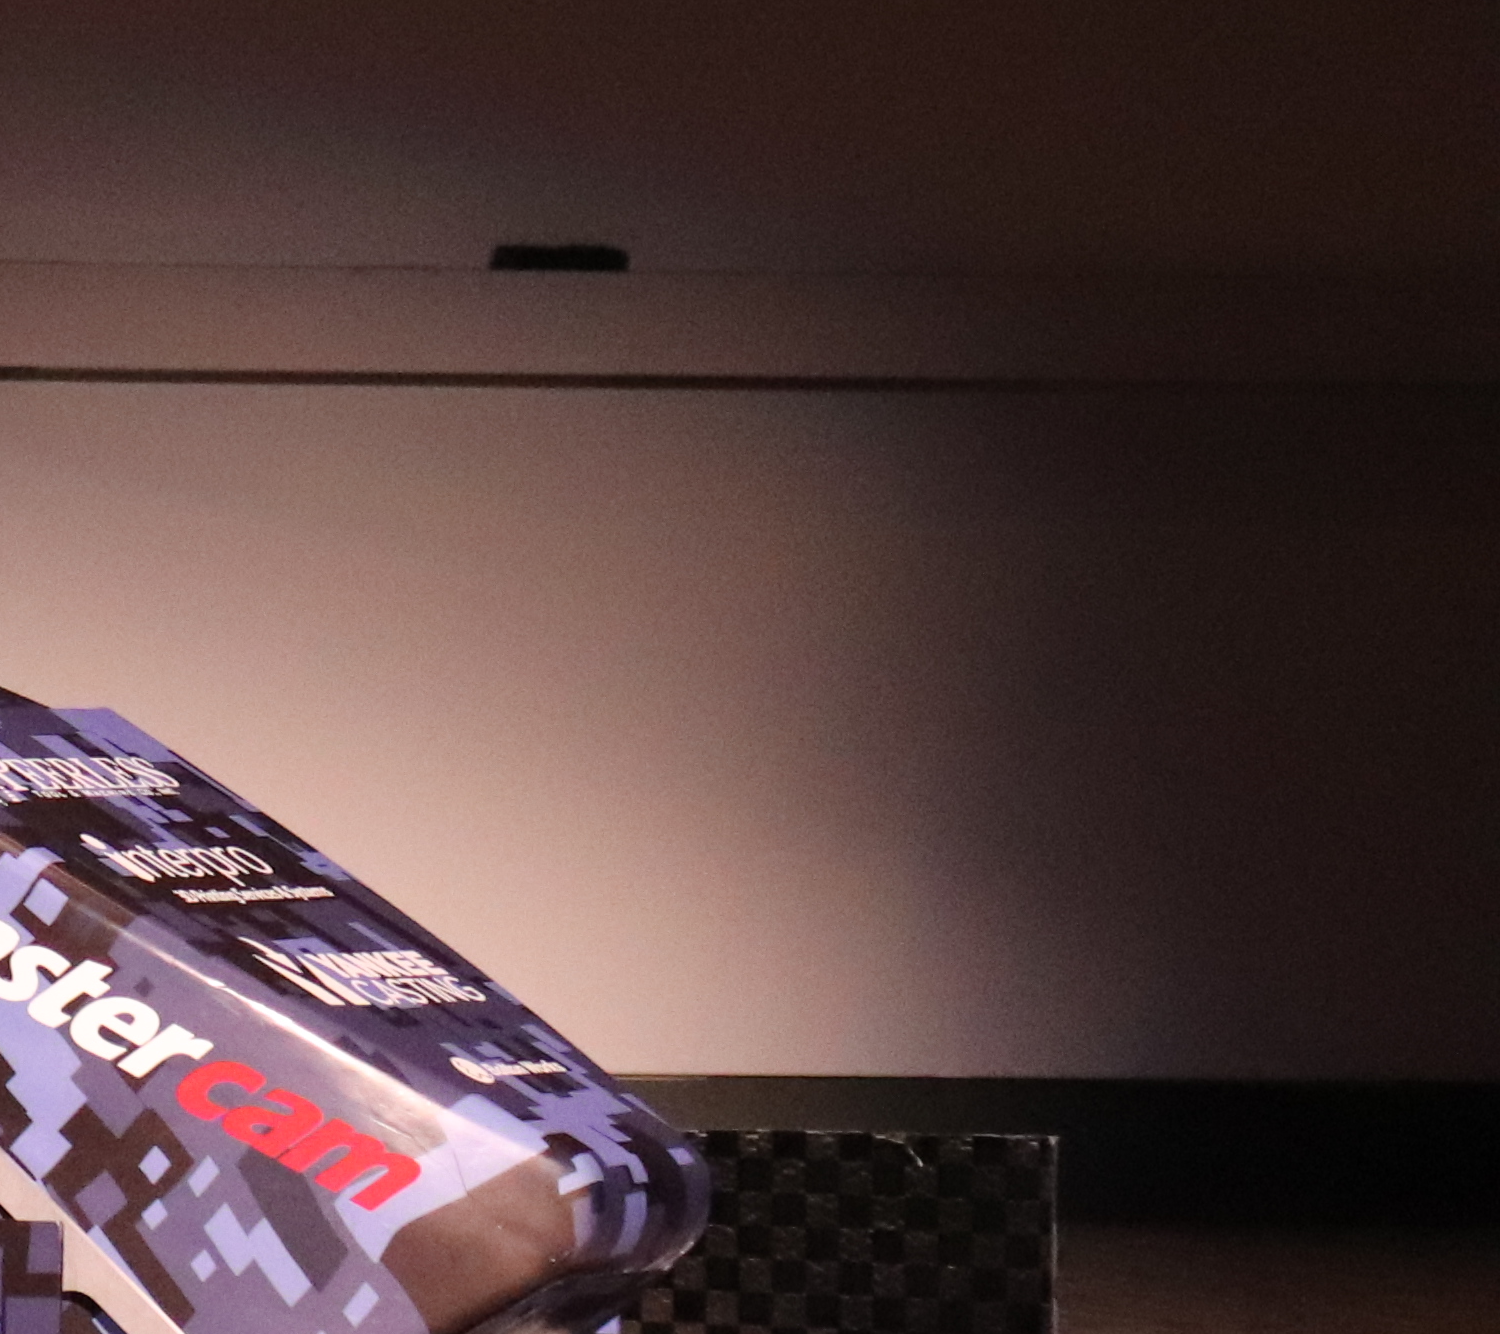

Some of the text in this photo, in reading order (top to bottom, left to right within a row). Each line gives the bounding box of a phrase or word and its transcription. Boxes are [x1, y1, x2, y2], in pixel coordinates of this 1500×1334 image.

[79, 833, 275, 887] interpro
[305, 950, 450, 978] YANKEE
[351, 976, 487, 1007] CASTING
